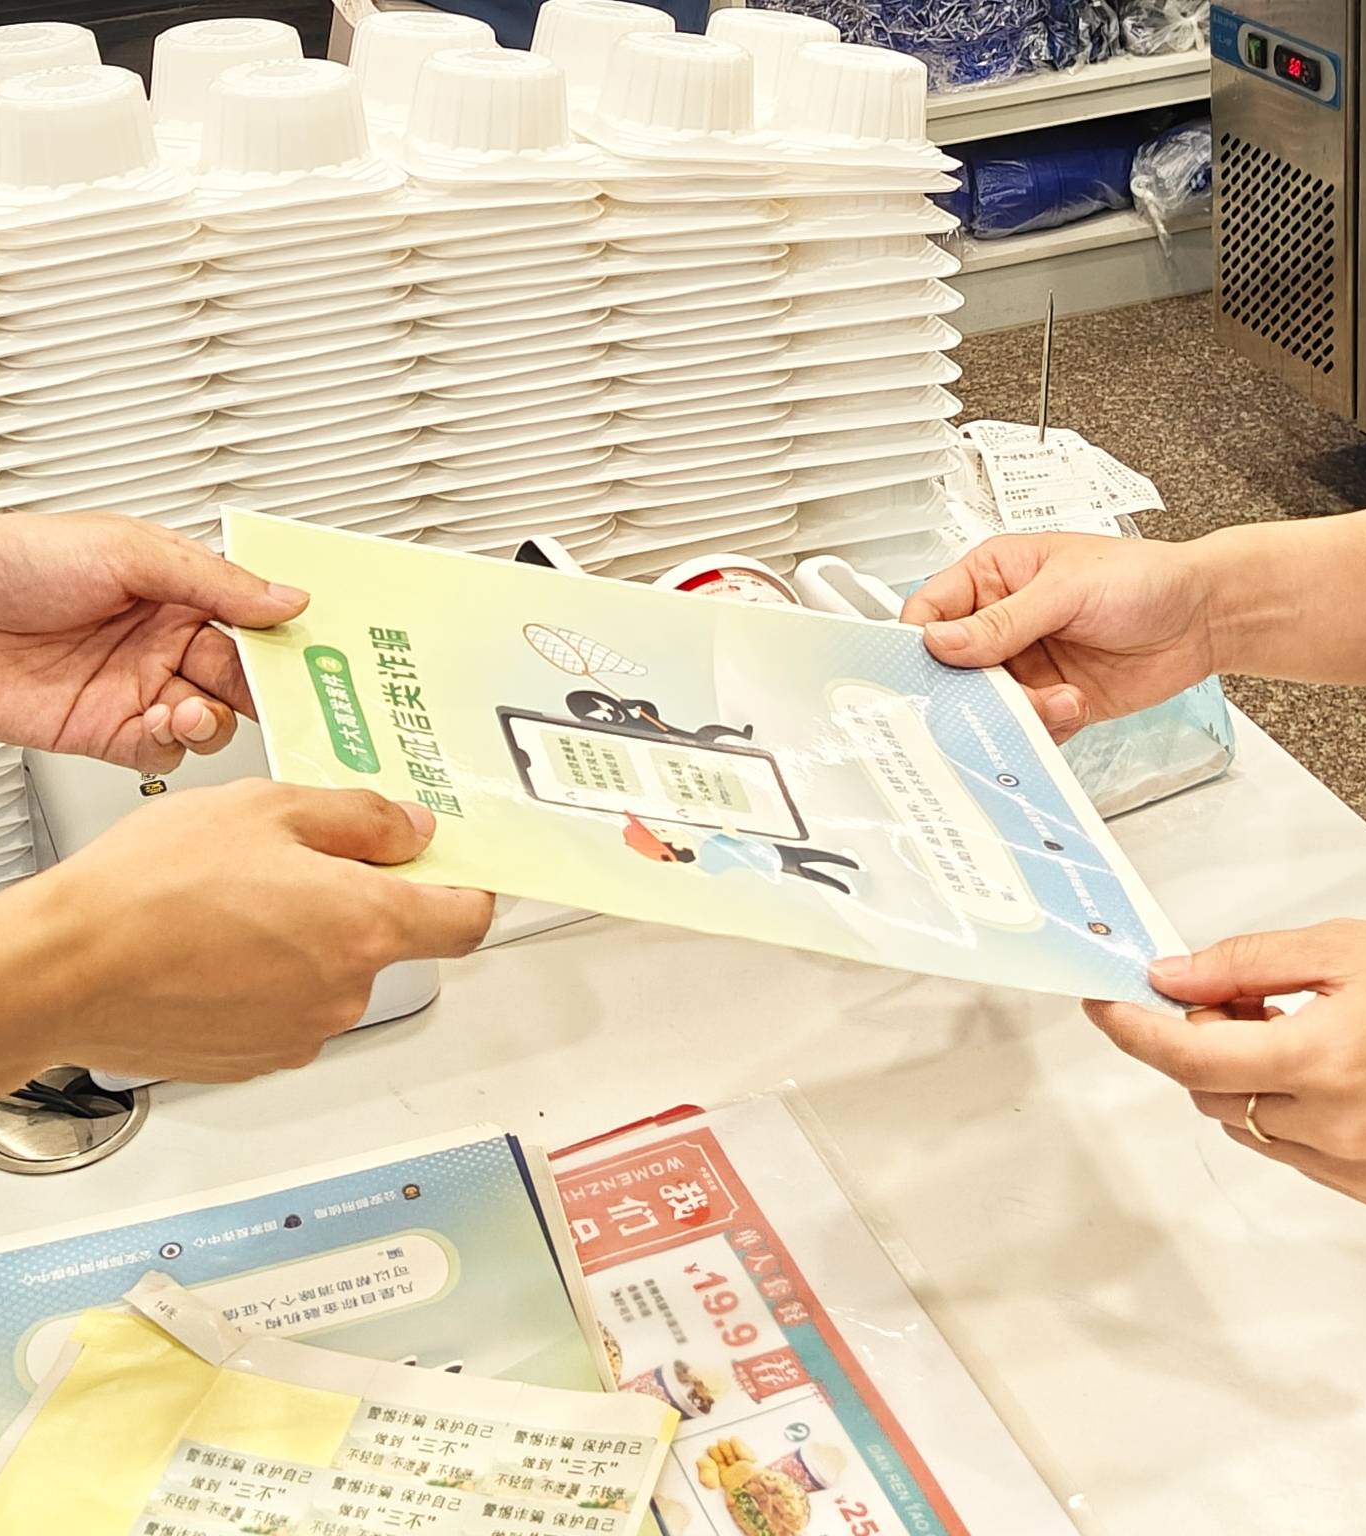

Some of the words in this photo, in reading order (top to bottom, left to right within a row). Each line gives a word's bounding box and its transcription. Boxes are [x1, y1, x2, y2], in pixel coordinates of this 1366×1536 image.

[368, 625, 465, 819] 虚假征信类诈骗
[313, 1189, 398, 1221] 公安部刑侦局
[193, 1218, 280, 1249] 国家反诈中心
[733, 1226, 810, 1327] 单人套餐
[221, 1264, 412, 1323] 可以帮助消除个人征信
[683, 1262, 760, 1348] ¥19.9
[751, 1354, 801, 1389] 荐
[366, 1405, 428, 1430] 警惕诈骗
[434, 1417, 495, 1440] 保护自己
[373, 1431, 406, 1450] 做到
[513, 1429, 576, 1452] 警惕诈骗
[582, 1438, 643, 1457] 保护自己
[185, 1446, 246, 1474] 警惕诈骗
[251, 1461, 314, 1486] 保护自己
[346, 1447, 386, 1467] 不轻信
[521, 1455, 554, 1472] 做到
[189, 1475, 223, 1494] 做到
[494, 1472, 535, 1492] 不轻信
[161, 1490, 201, 1513] 不轻信
[338, 1502, 371, 1521] 做到
[400, 1487, 463, 1512] 保护自己
[481, 1501, 546, 1524] 警惕诈骗
[552, 1512, 617, 1533] 保护自己
